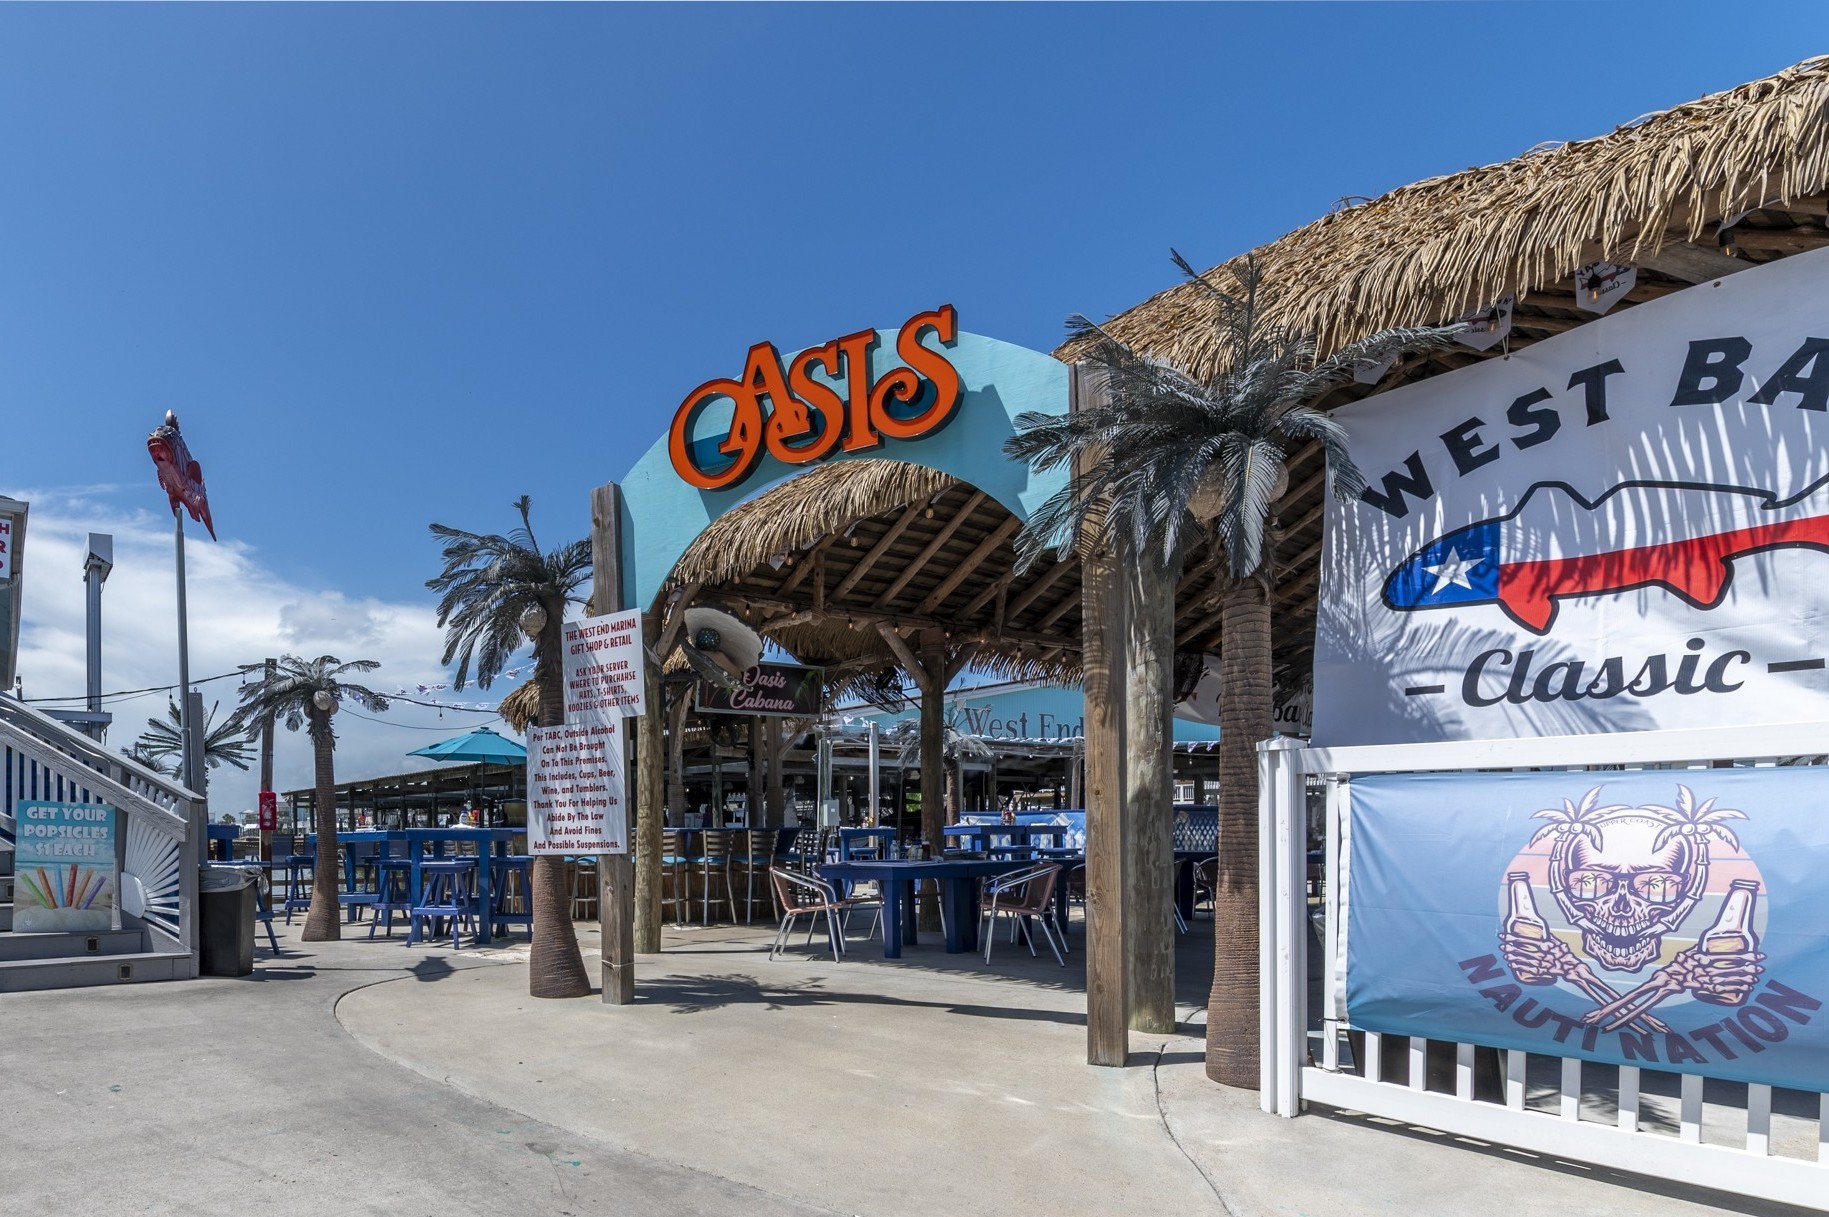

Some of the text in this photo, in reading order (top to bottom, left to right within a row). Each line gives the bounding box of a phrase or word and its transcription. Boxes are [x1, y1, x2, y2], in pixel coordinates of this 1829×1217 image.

[668, 304, 963, 490] OASIS
[1359, 358, 1625, 519] WEST
[566, 618, 636, 642] THE WEST END MARINA
[571, 634, 632, 655] GIFT SHOP & RETAIL
[576, 660, 628, 677] ASK YOUR SERVER
[1461, 637, 1751, 707] Classic
[570, 679, 590, 689] WHERE
[592, 677, 599, 686] TO
[743, 665, 786, 688] Oasis
[579, 685, 627, 699] HATS, T-SHIRTS,
[730, 689, 794, 710] Cabana
[568, 695, 639, 713] KOOZIES & OTHER ITEMS
[964, 707, 1083, 741] West End
[533, 724, 614, 742] Per TABC, Outside Alcohol
[543, 741, 605, 754] Can Not Be Brought
[541, 756, 607, 768] On To This Premises.
[535, 769, 615, 782] This Includes, Cups, Beer,
[542, 784, 608, 795] Wine, and Tumblers.
[534, 800, 553, 809] Thank
[569, 799, 579, 807] For
[581, 798, 606, 807] Helping
[609, 797, 617, 805] Us
[27, 807, 107, 821] GET YOUR
[547, 812, 604, 822] Abide By The Law
[24, 824, 108, 839] POPSICLES
[550, 827, 562, 835] And
[565, 826, 582, 835] Avoid
[36, 842, 95, 856] $1 EACH
[534, 840, 619, 850] And Possible Suspensions.
[1457, 953, 1822, 1064] NAUTI NATION
